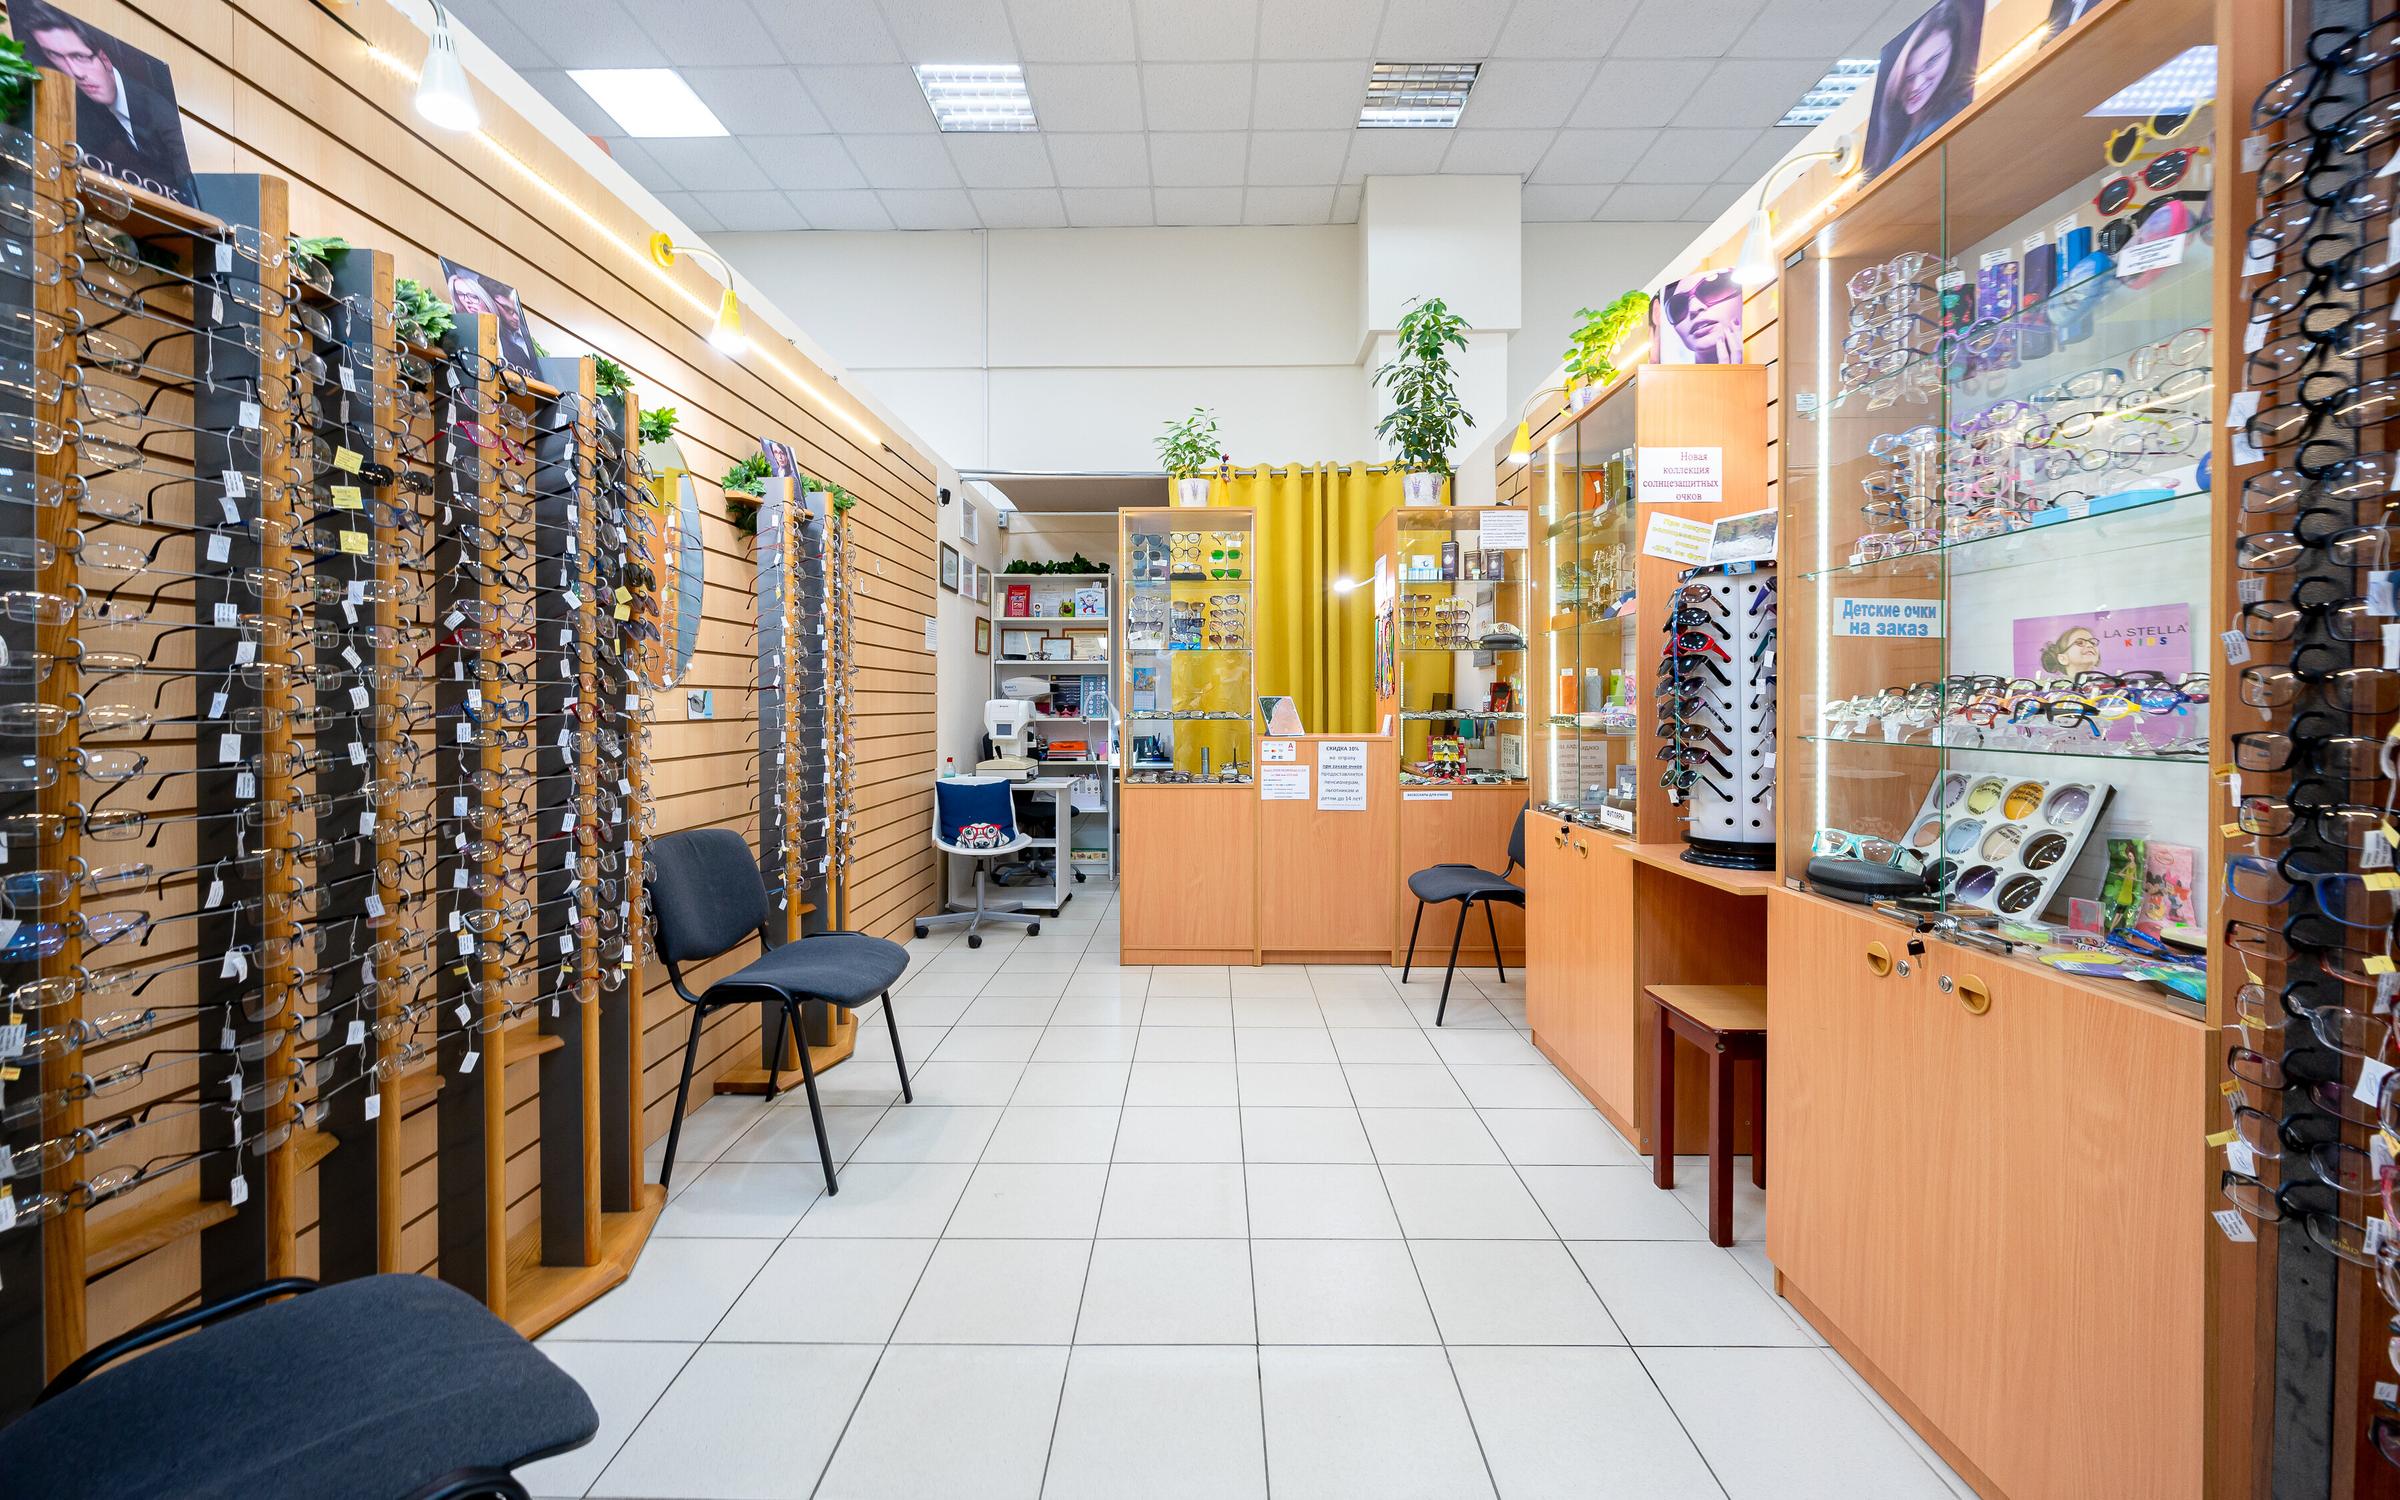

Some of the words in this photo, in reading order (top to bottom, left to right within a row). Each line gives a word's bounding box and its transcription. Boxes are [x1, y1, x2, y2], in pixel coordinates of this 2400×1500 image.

[1681, 452, 1708, 461] Новая
[1663, 467, 1710, 475] коллекция
[1642, 480, 1719, 488] солнцезащитных
[1675, 493, 1702, 501] очков
[1843, 599, 1900, 619] Детские
[1904, 605, 1937, 618] очки
[1849, 622, 1870, 635] на
[1876, 622, 1929, 637] заказ
[2104, 630, 2121, 638] LA
[2126, 625, 2186, 637] STELLA
